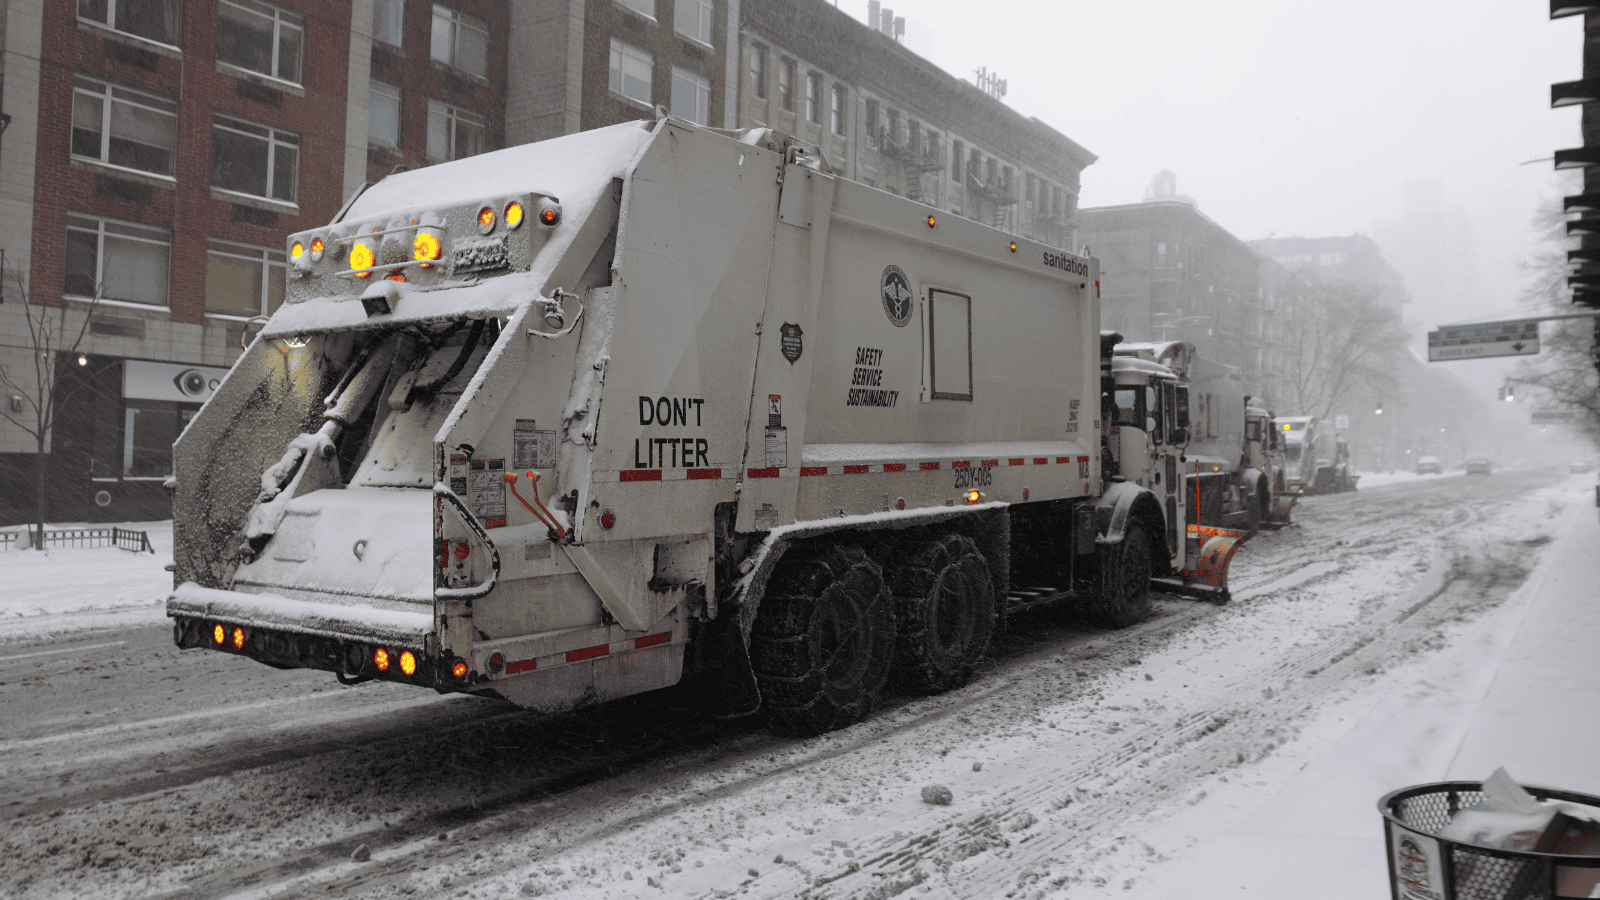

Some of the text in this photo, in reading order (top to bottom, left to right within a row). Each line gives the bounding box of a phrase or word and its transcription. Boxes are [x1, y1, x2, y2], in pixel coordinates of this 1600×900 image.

[1043, 251, 1089, 278] sanitation
[855, 346, 883, 366] SAFETY
[851, 367, 883, 387] SERVICE
[846, 388, 899, 408] SUSTAINABILITY
[639, 395, 705, 427] DON'T
[635, 437, 710, 469] LITTER
